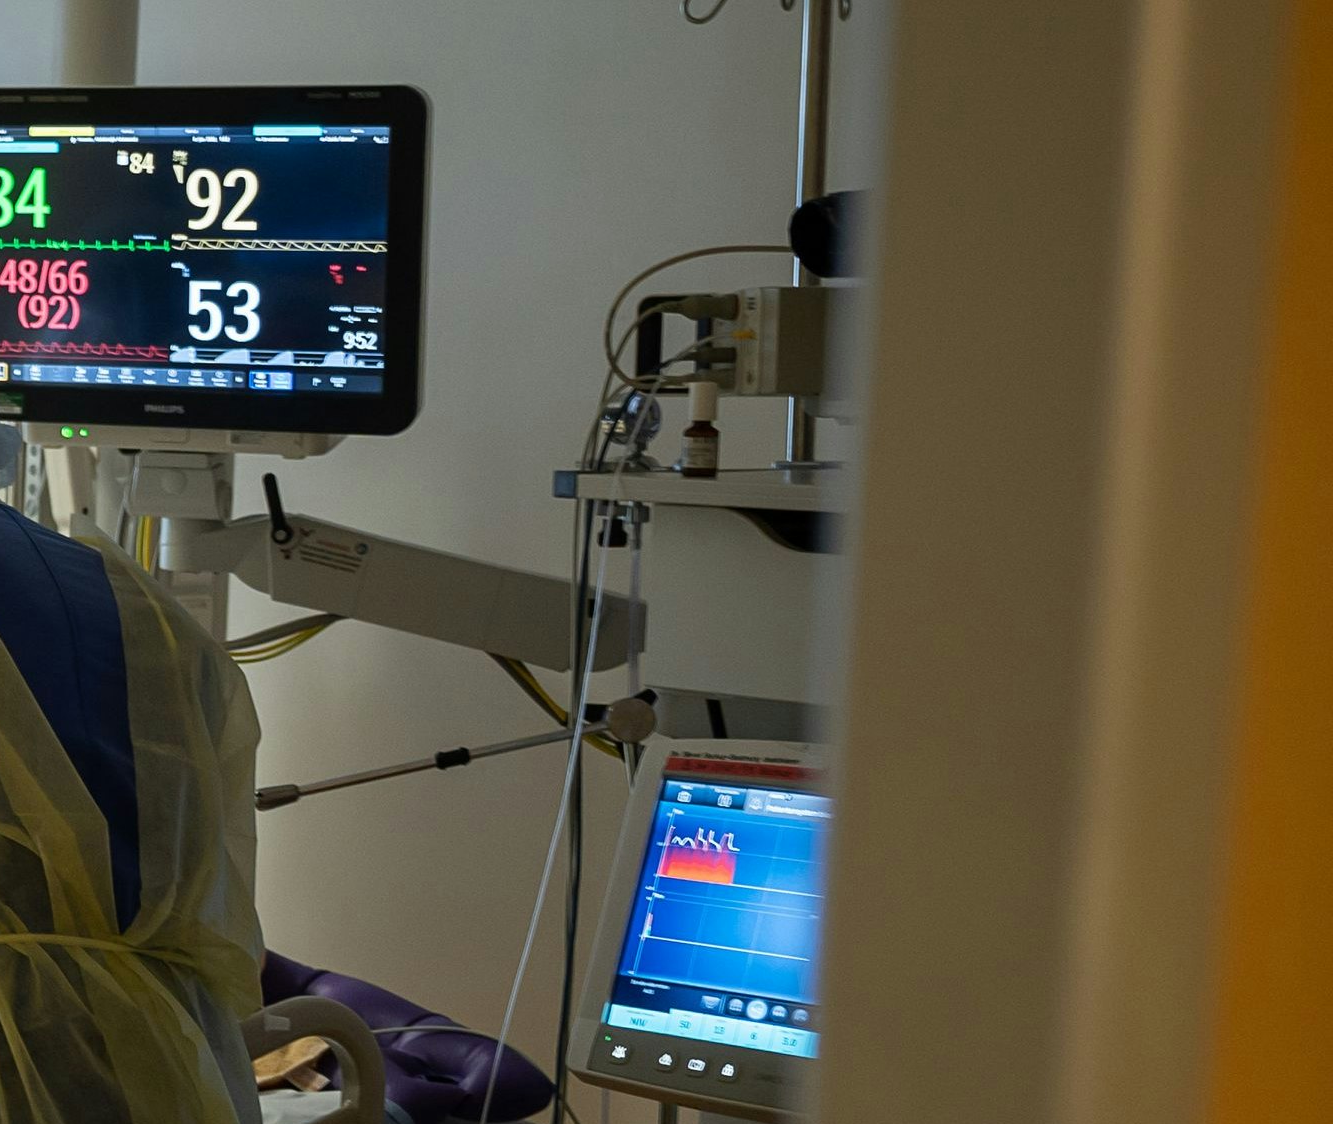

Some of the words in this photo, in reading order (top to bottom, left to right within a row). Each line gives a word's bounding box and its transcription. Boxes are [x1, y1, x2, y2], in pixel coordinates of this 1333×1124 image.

[129, 152, 155, 174] 84
[186, 168, 259, 231] 92
[17, 294, 81, 330] (92)
[188, 280, 261, 342] 53
[343, 332, 379, 350] 952
